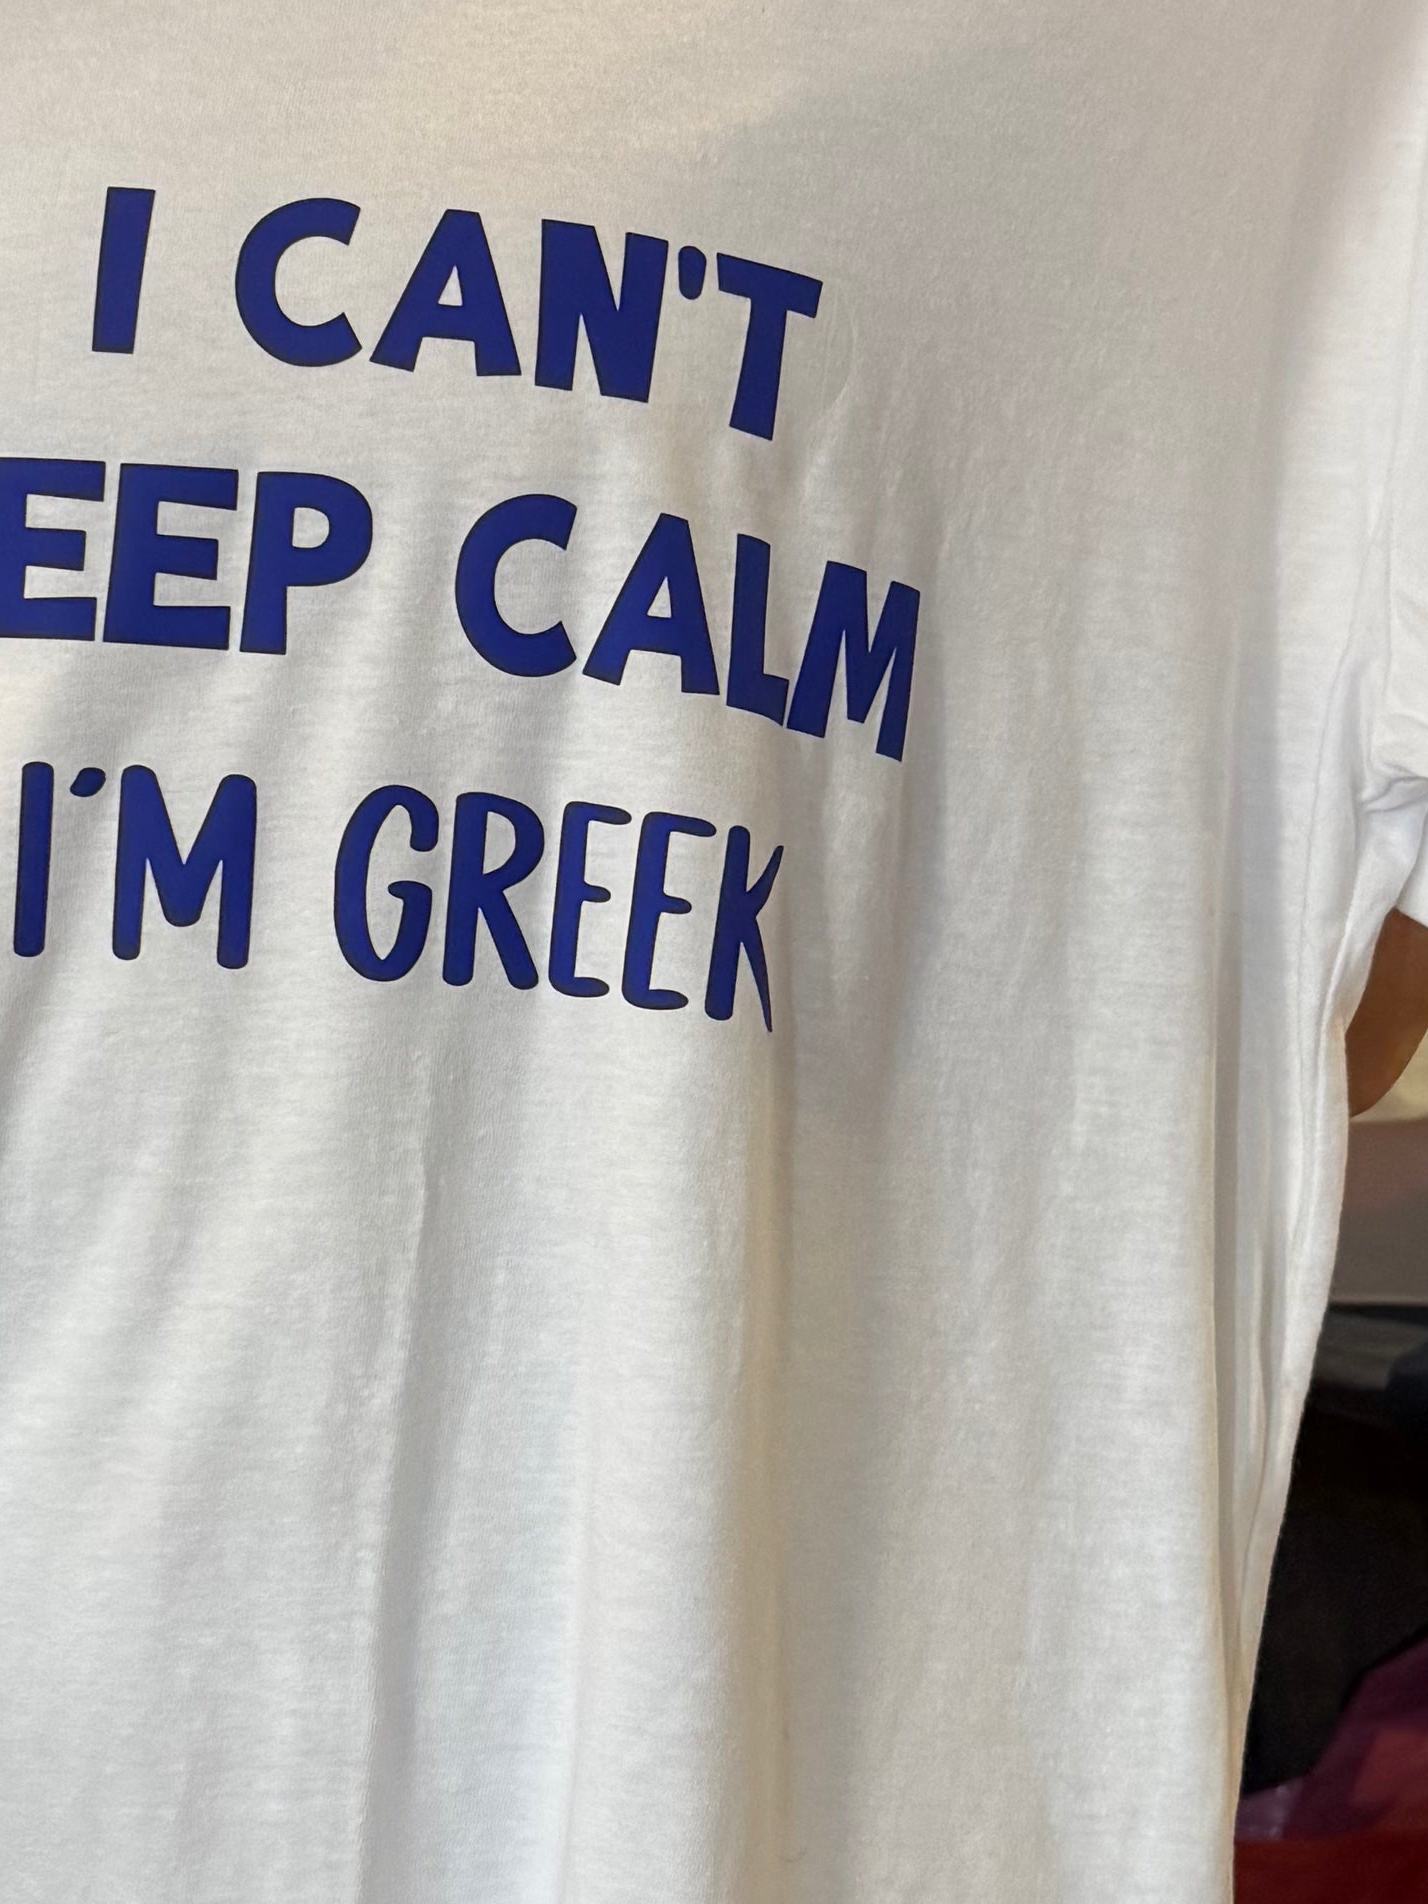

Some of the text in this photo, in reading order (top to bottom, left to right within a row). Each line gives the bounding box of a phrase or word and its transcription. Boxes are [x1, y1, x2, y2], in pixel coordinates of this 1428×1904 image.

[92, 187, 823, 441] I CAN'T
[455, 494, 920, 762] CALM
[13, 762, 784, 1032] I'M GREEK
